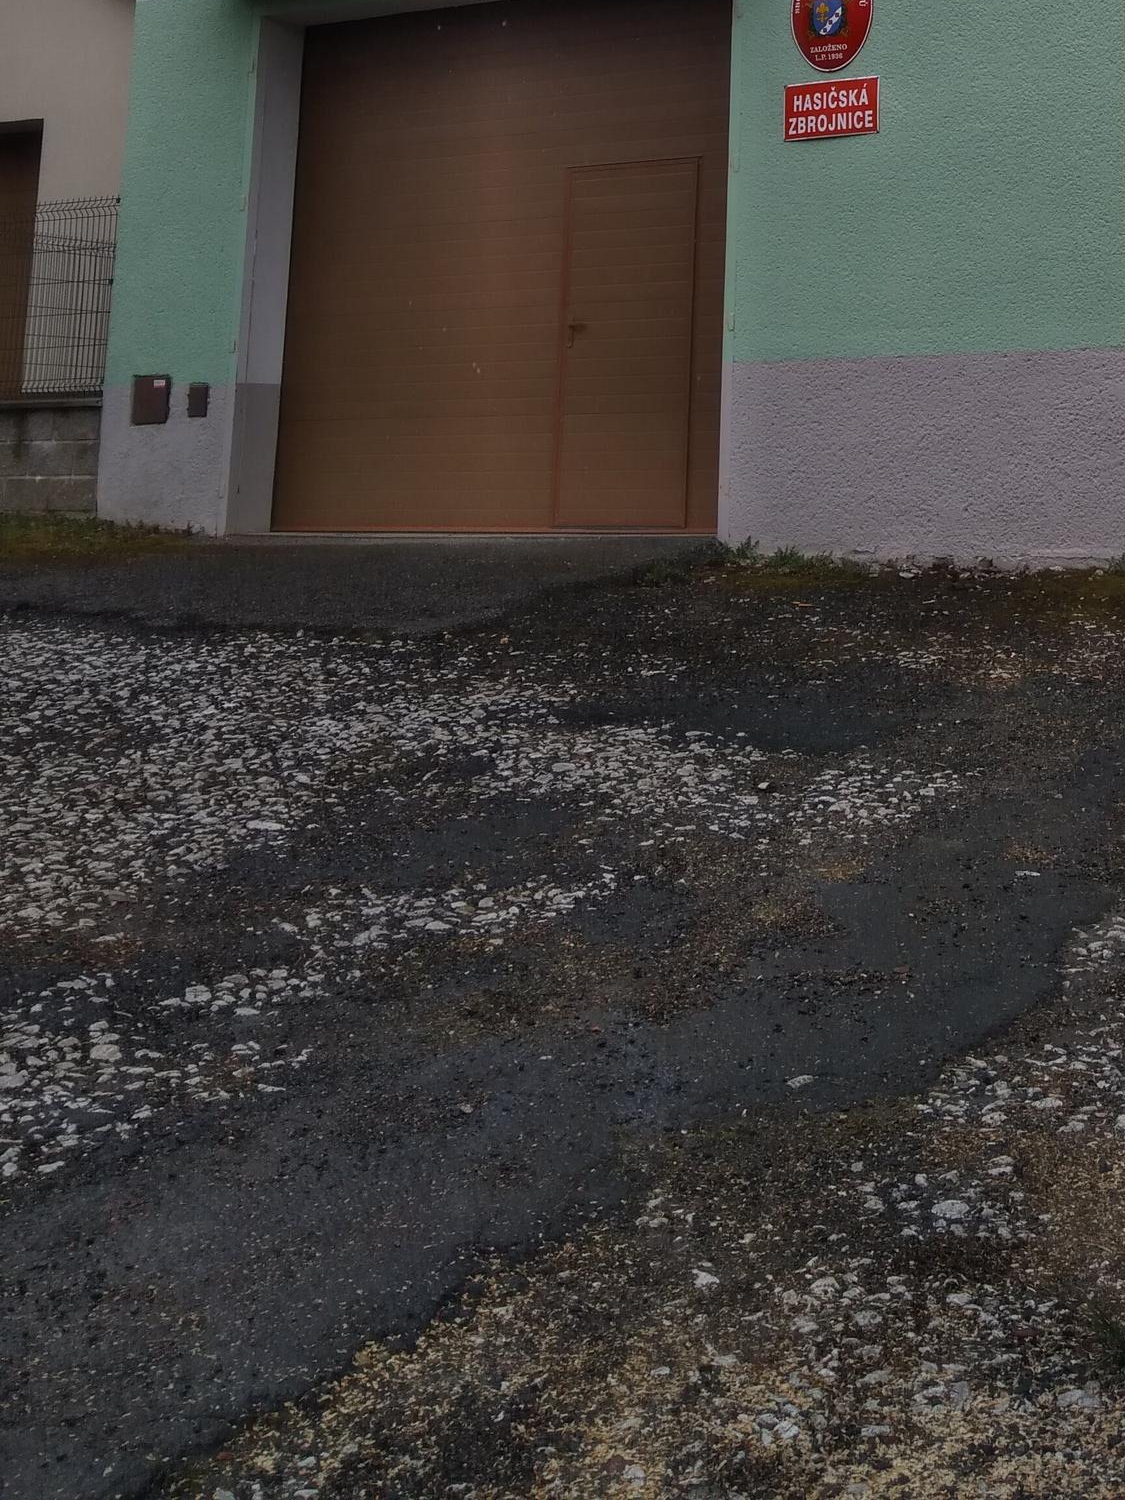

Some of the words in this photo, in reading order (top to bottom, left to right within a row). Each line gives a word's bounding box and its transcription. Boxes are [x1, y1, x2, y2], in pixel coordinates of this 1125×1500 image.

[810, 43, 848, 53] ZALOŽENO
[793, 83, 869, 112] HASIČSKÁ
[788, 110, 874, 135] ZBROJNICE
